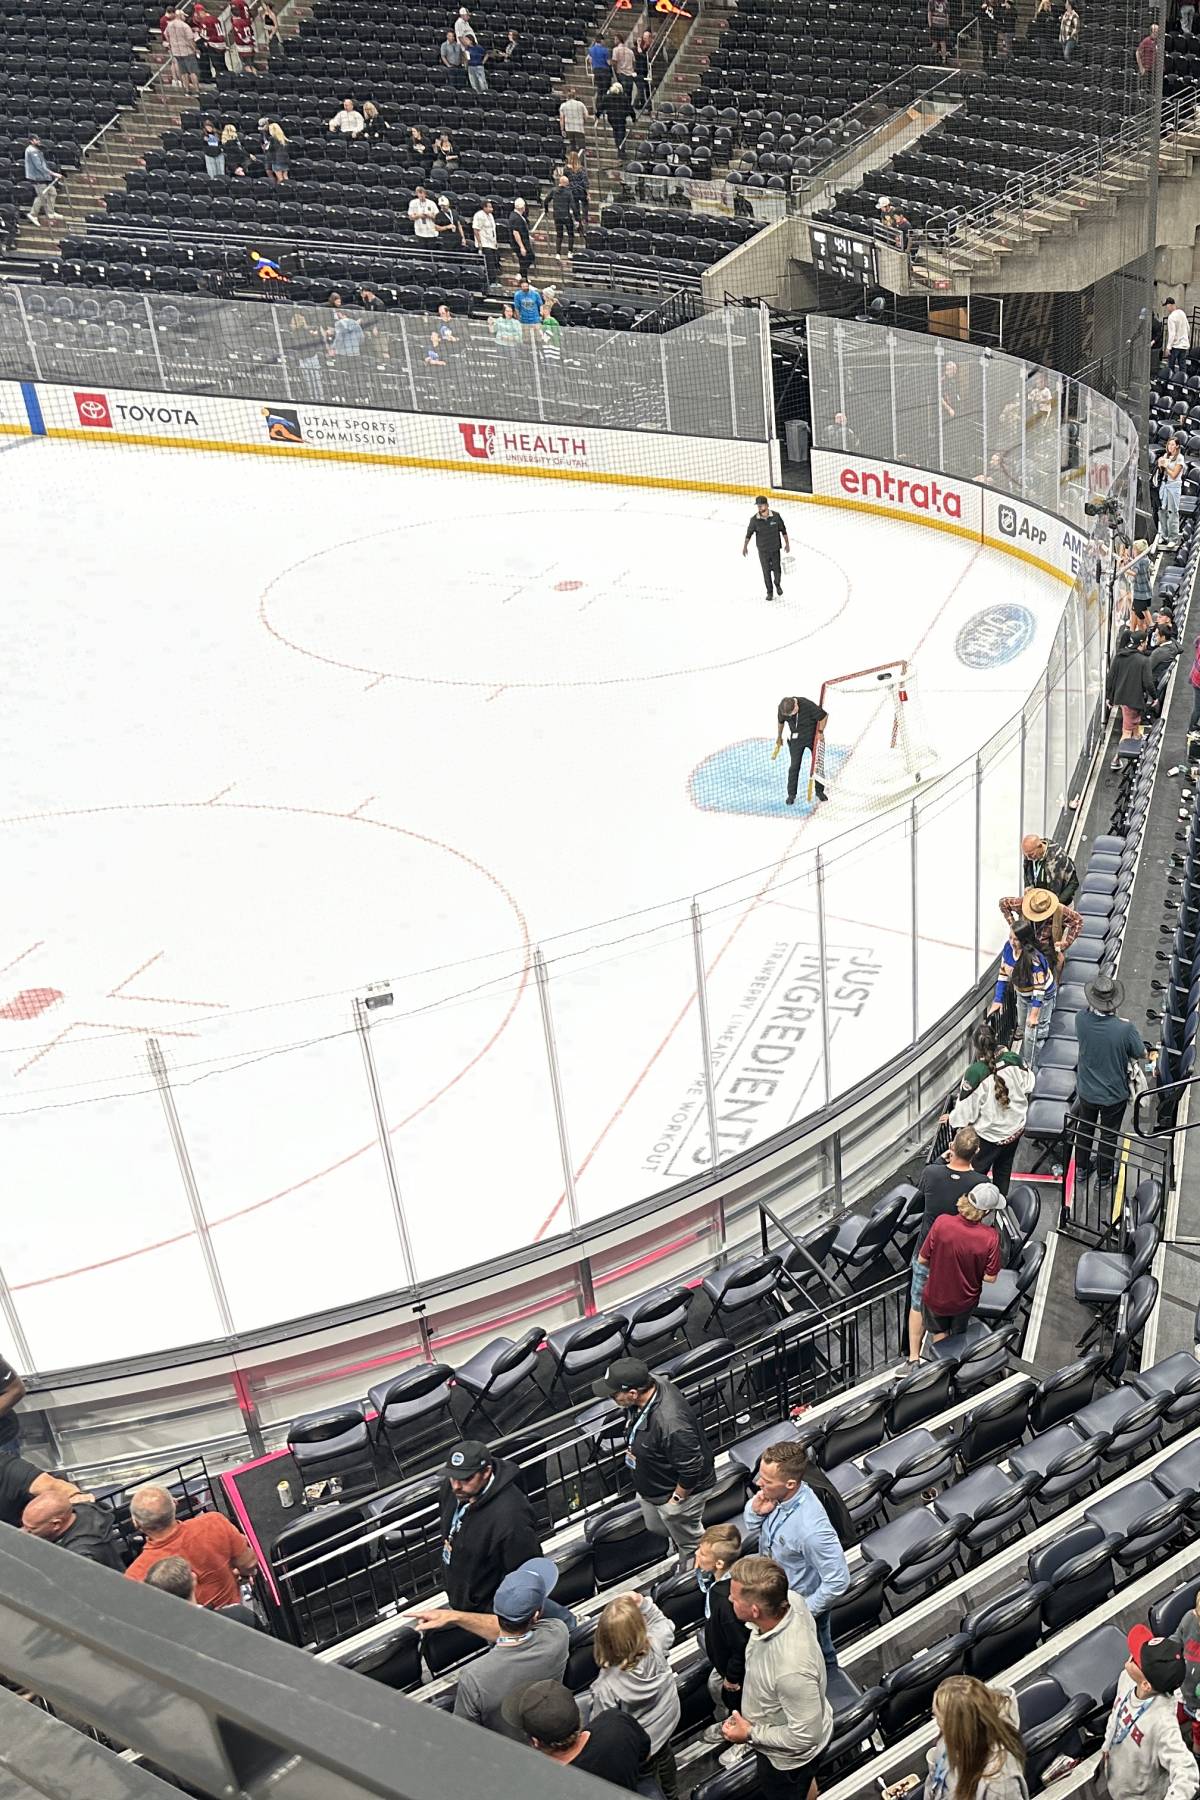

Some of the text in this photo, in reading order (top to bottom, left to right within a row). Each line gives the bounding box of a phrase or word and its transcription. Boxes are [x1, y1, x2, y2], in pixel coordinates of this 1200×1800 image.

[116, 404, 199, 426] TOYOTA
[303, 416, 396, 433] UTAH SPORTS
[306, 429, 397, 446] COMMISSION
[503, 433, 587, 456] HEALTH
[505, 454, 588, 469] UNIVERSITY OF UTAH
[840, 468, 962, 519] entrata
[740, 941, 789, 1009] STRAWBERRY
[828, 955, 883, 1018] JUST
[691, 955, 841, 1165] INGREDIENTS
[641, 1100, 697, 1173] WORKOUT
